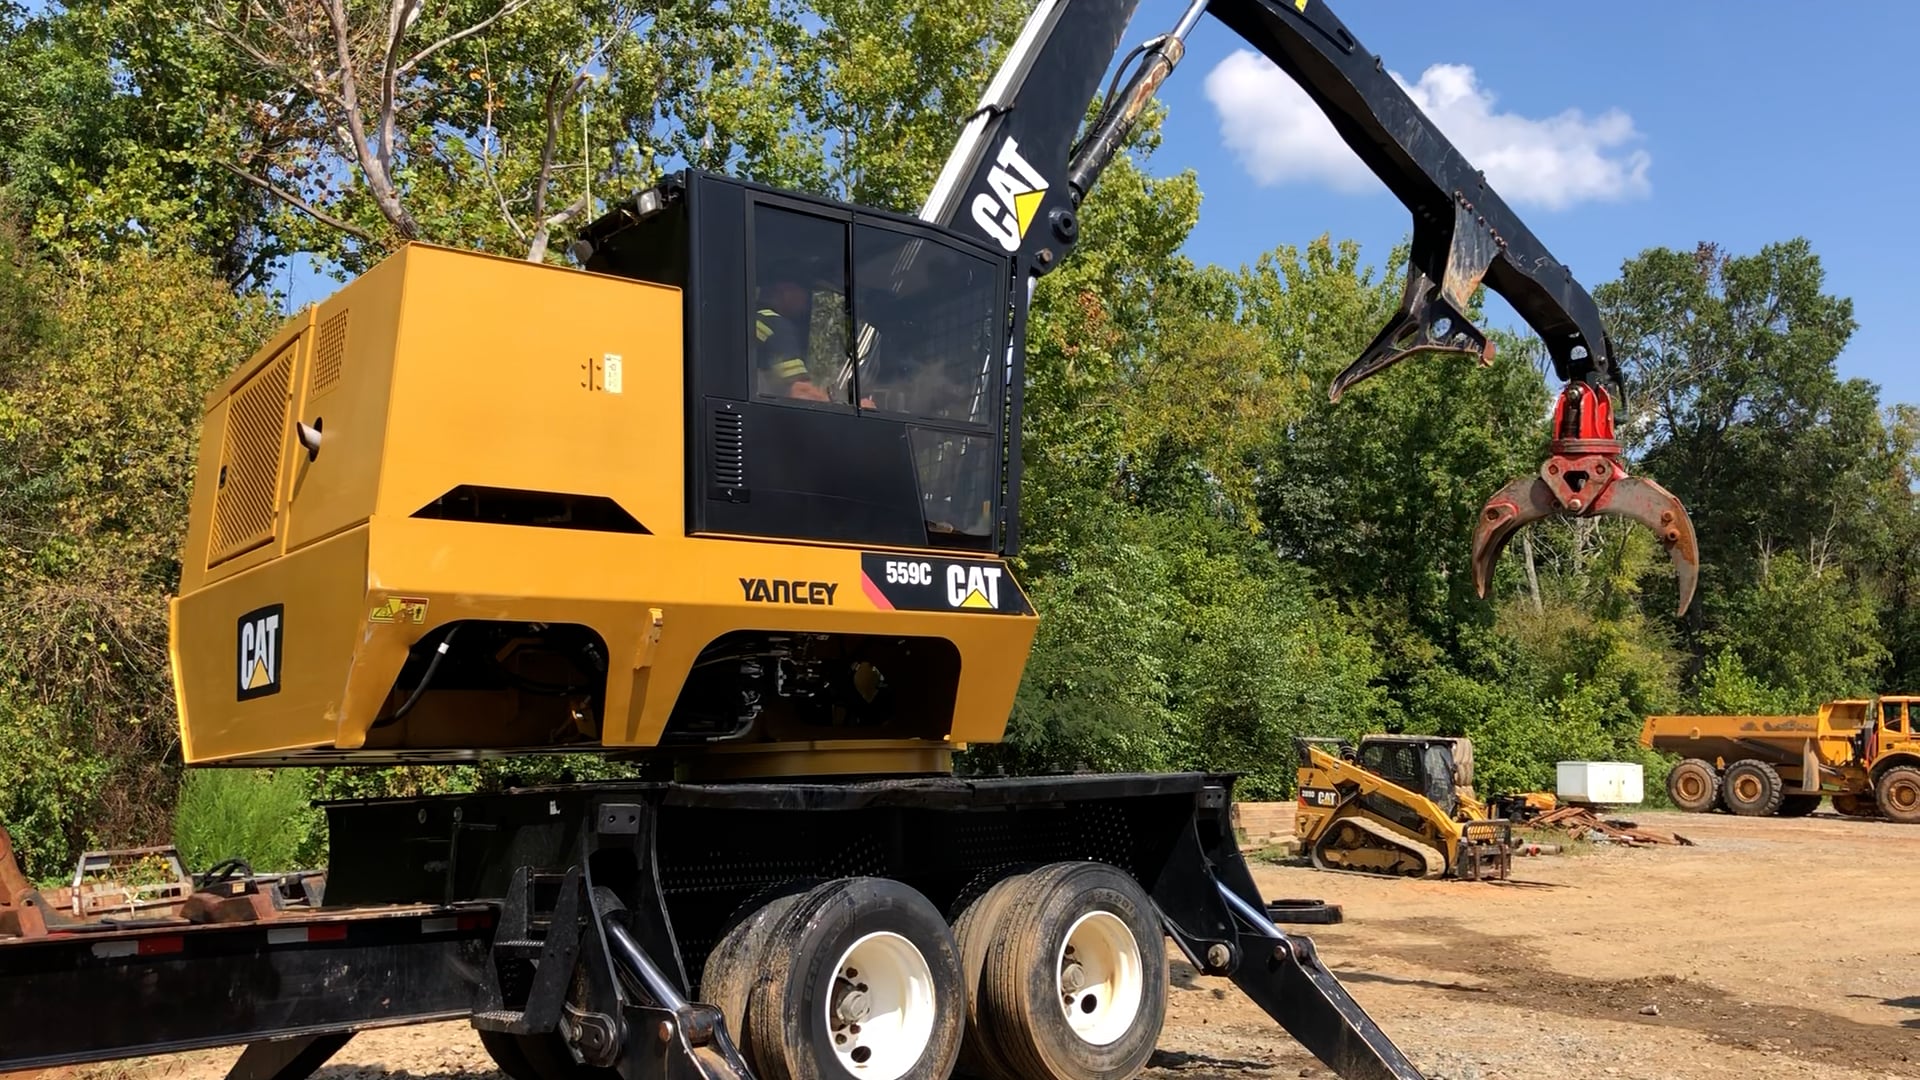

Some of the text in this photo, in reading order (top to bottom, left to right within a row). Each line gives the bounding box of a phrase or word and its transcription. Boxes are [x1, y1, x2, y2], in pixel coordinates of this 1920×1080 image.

[971, 135, 1050, 252] CAT
[739, 577, 839, 606] YANCEY
[885, 560, 1002, 609] 559C CAT
[241, 614, 279, 690] CAT
[1317, 791, 1337, 806] CAT
